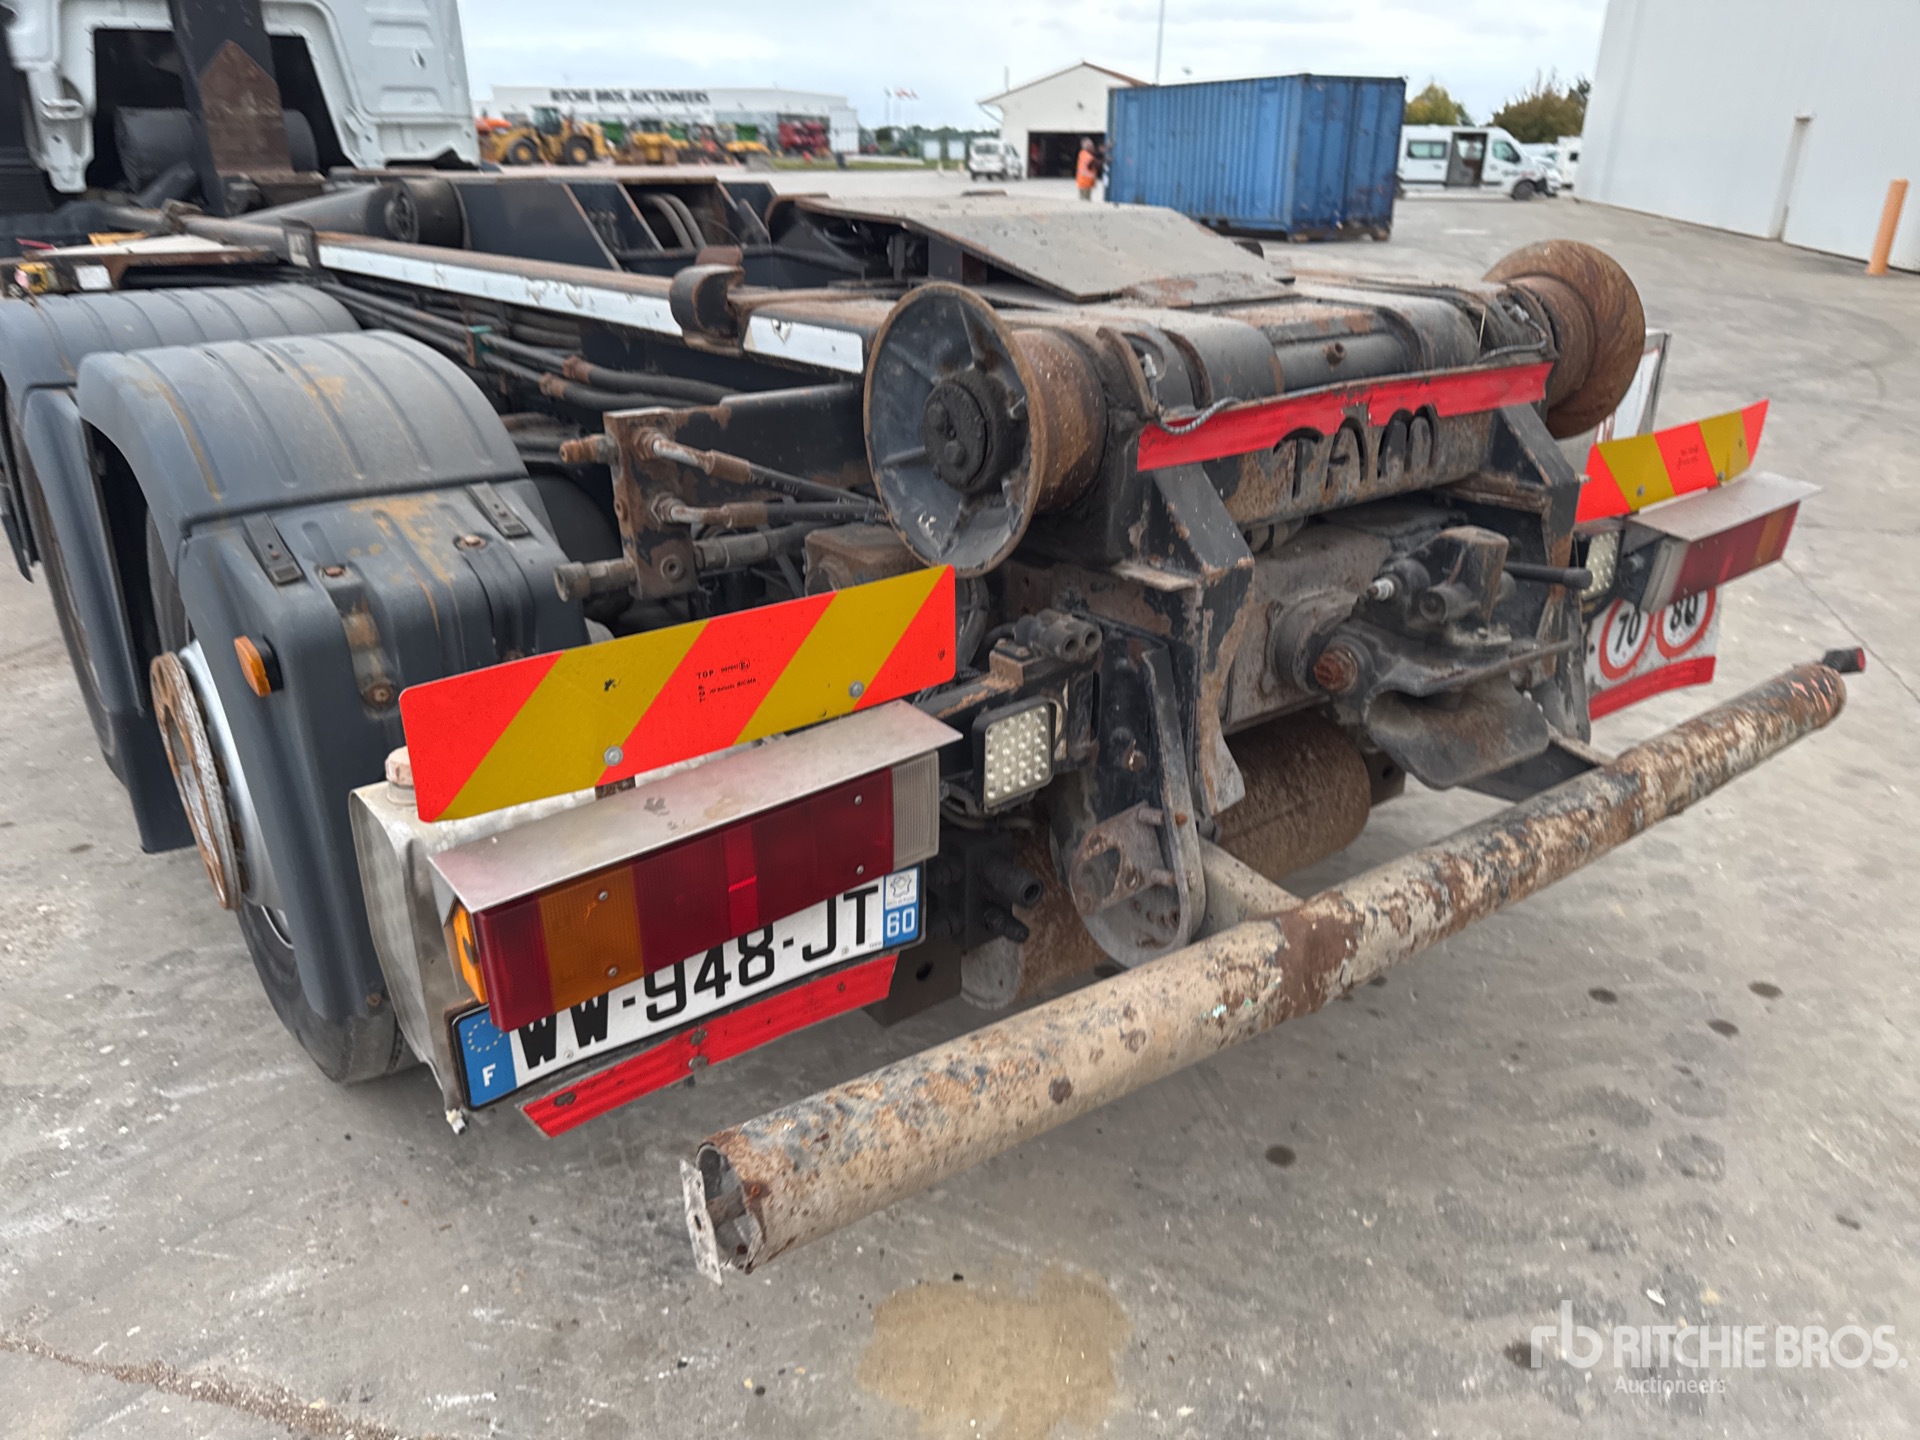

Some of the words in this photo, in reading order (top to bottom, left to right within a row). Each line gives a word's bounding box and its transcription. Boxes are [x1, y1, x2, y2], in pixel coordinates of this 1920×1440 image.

[1615, 610, 1641, 654] 70
[697, 669, 714, 680] TOP
[886, 906, 916, 939] 60
[516, 886, 879, 1070] WW-948-JT
[482, 1063, 496, 1088] F
